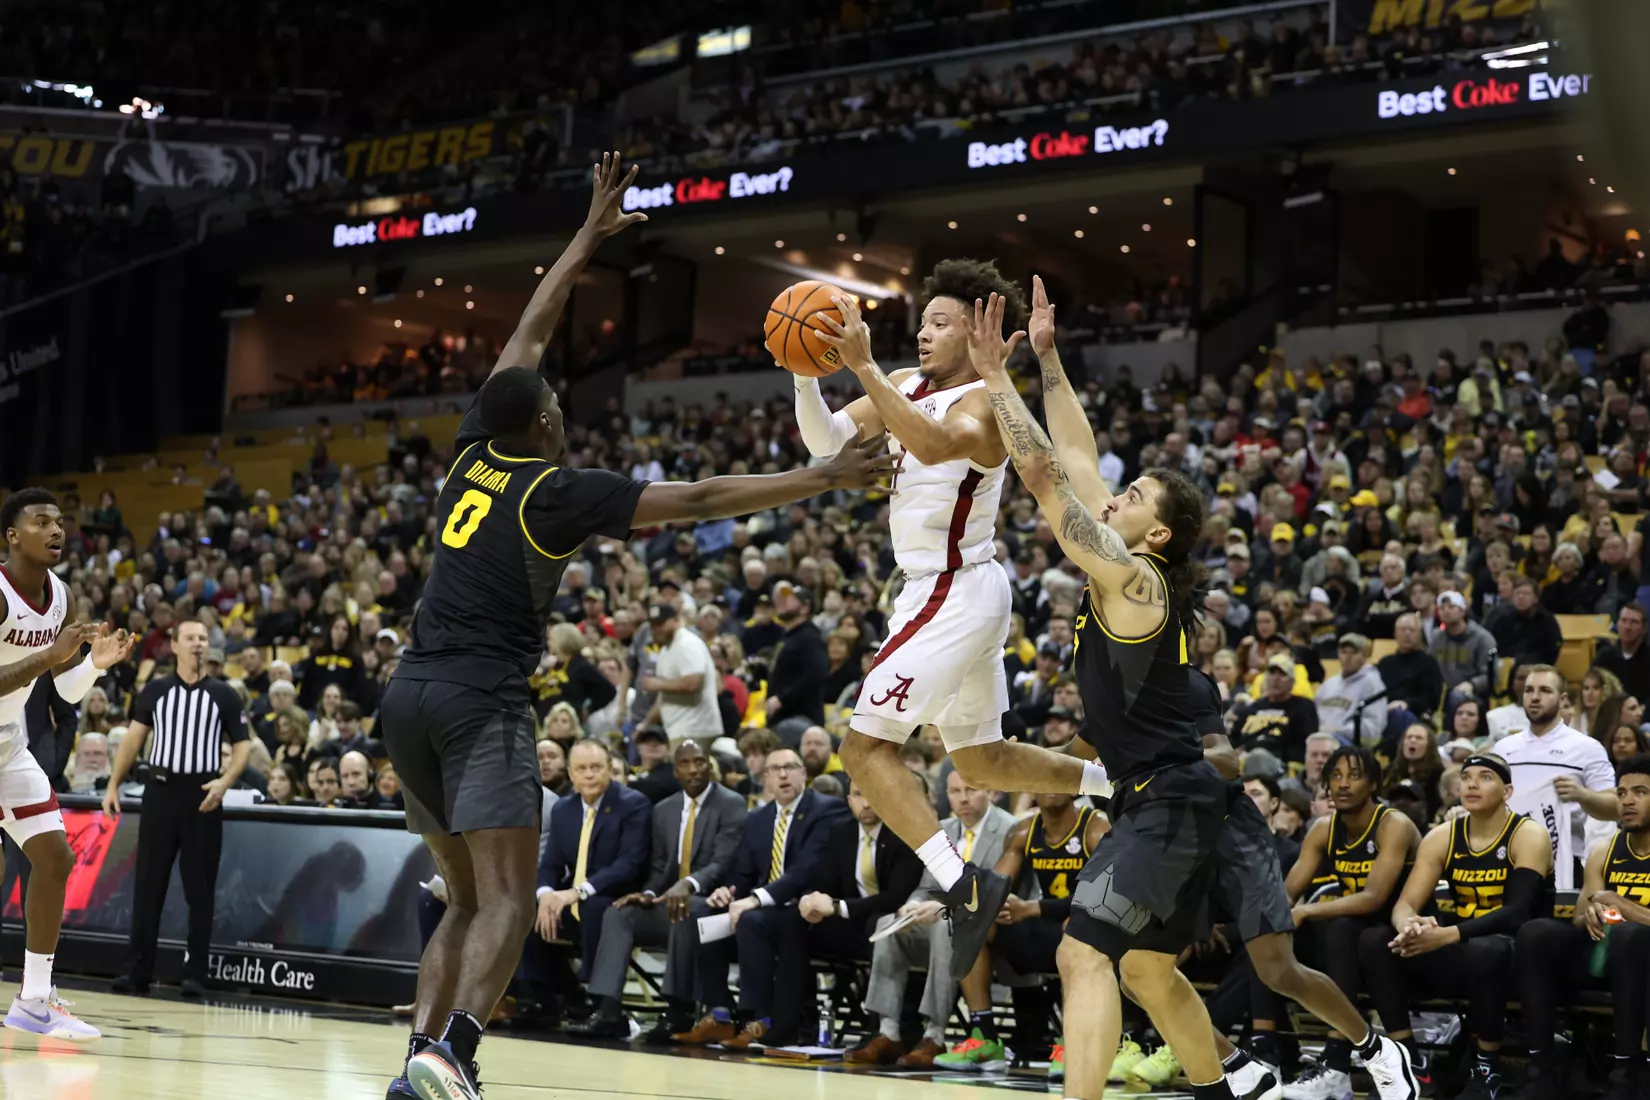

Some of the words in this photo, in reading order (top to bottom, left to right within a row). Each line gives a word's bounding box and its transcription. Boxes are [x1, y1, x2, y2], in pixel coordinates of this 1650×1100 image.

[1378, 85, 1447, 118] Best
[1452, 78, 1520, 109] Coke
[0, 135, 97, 178] OU
[344, 120, 495, 178] TIGERS
[968, 137, 1027, 168] Best
[1030, 131, 1089, 160] Coke
[1094, 119, 1169, 153] Ever?
[622, 182, 674, 211] Best
[675, 176, 726, 204] Coke
[729, 166, 793, 198] Ever?
[333, 221, 377, 247] Best
[377, 215, 420, 241] Coke
[422, 207, 477, 236] Ever?
[464, 459, 512, 494] DIARRA
[441, 489, 493, 549] 0
[3, 625, 59, 648] ALABAM
[1032, 858, 1083, 870] MIZZOU
[1335, 860, 1374, 873] MIZZO
[1452, 868, 1508, 883] MIZZOU
[1049, 872, 1070, 899] 4
[208, 954, 265, 984] Health
[270, 960, 315, 990] Care
